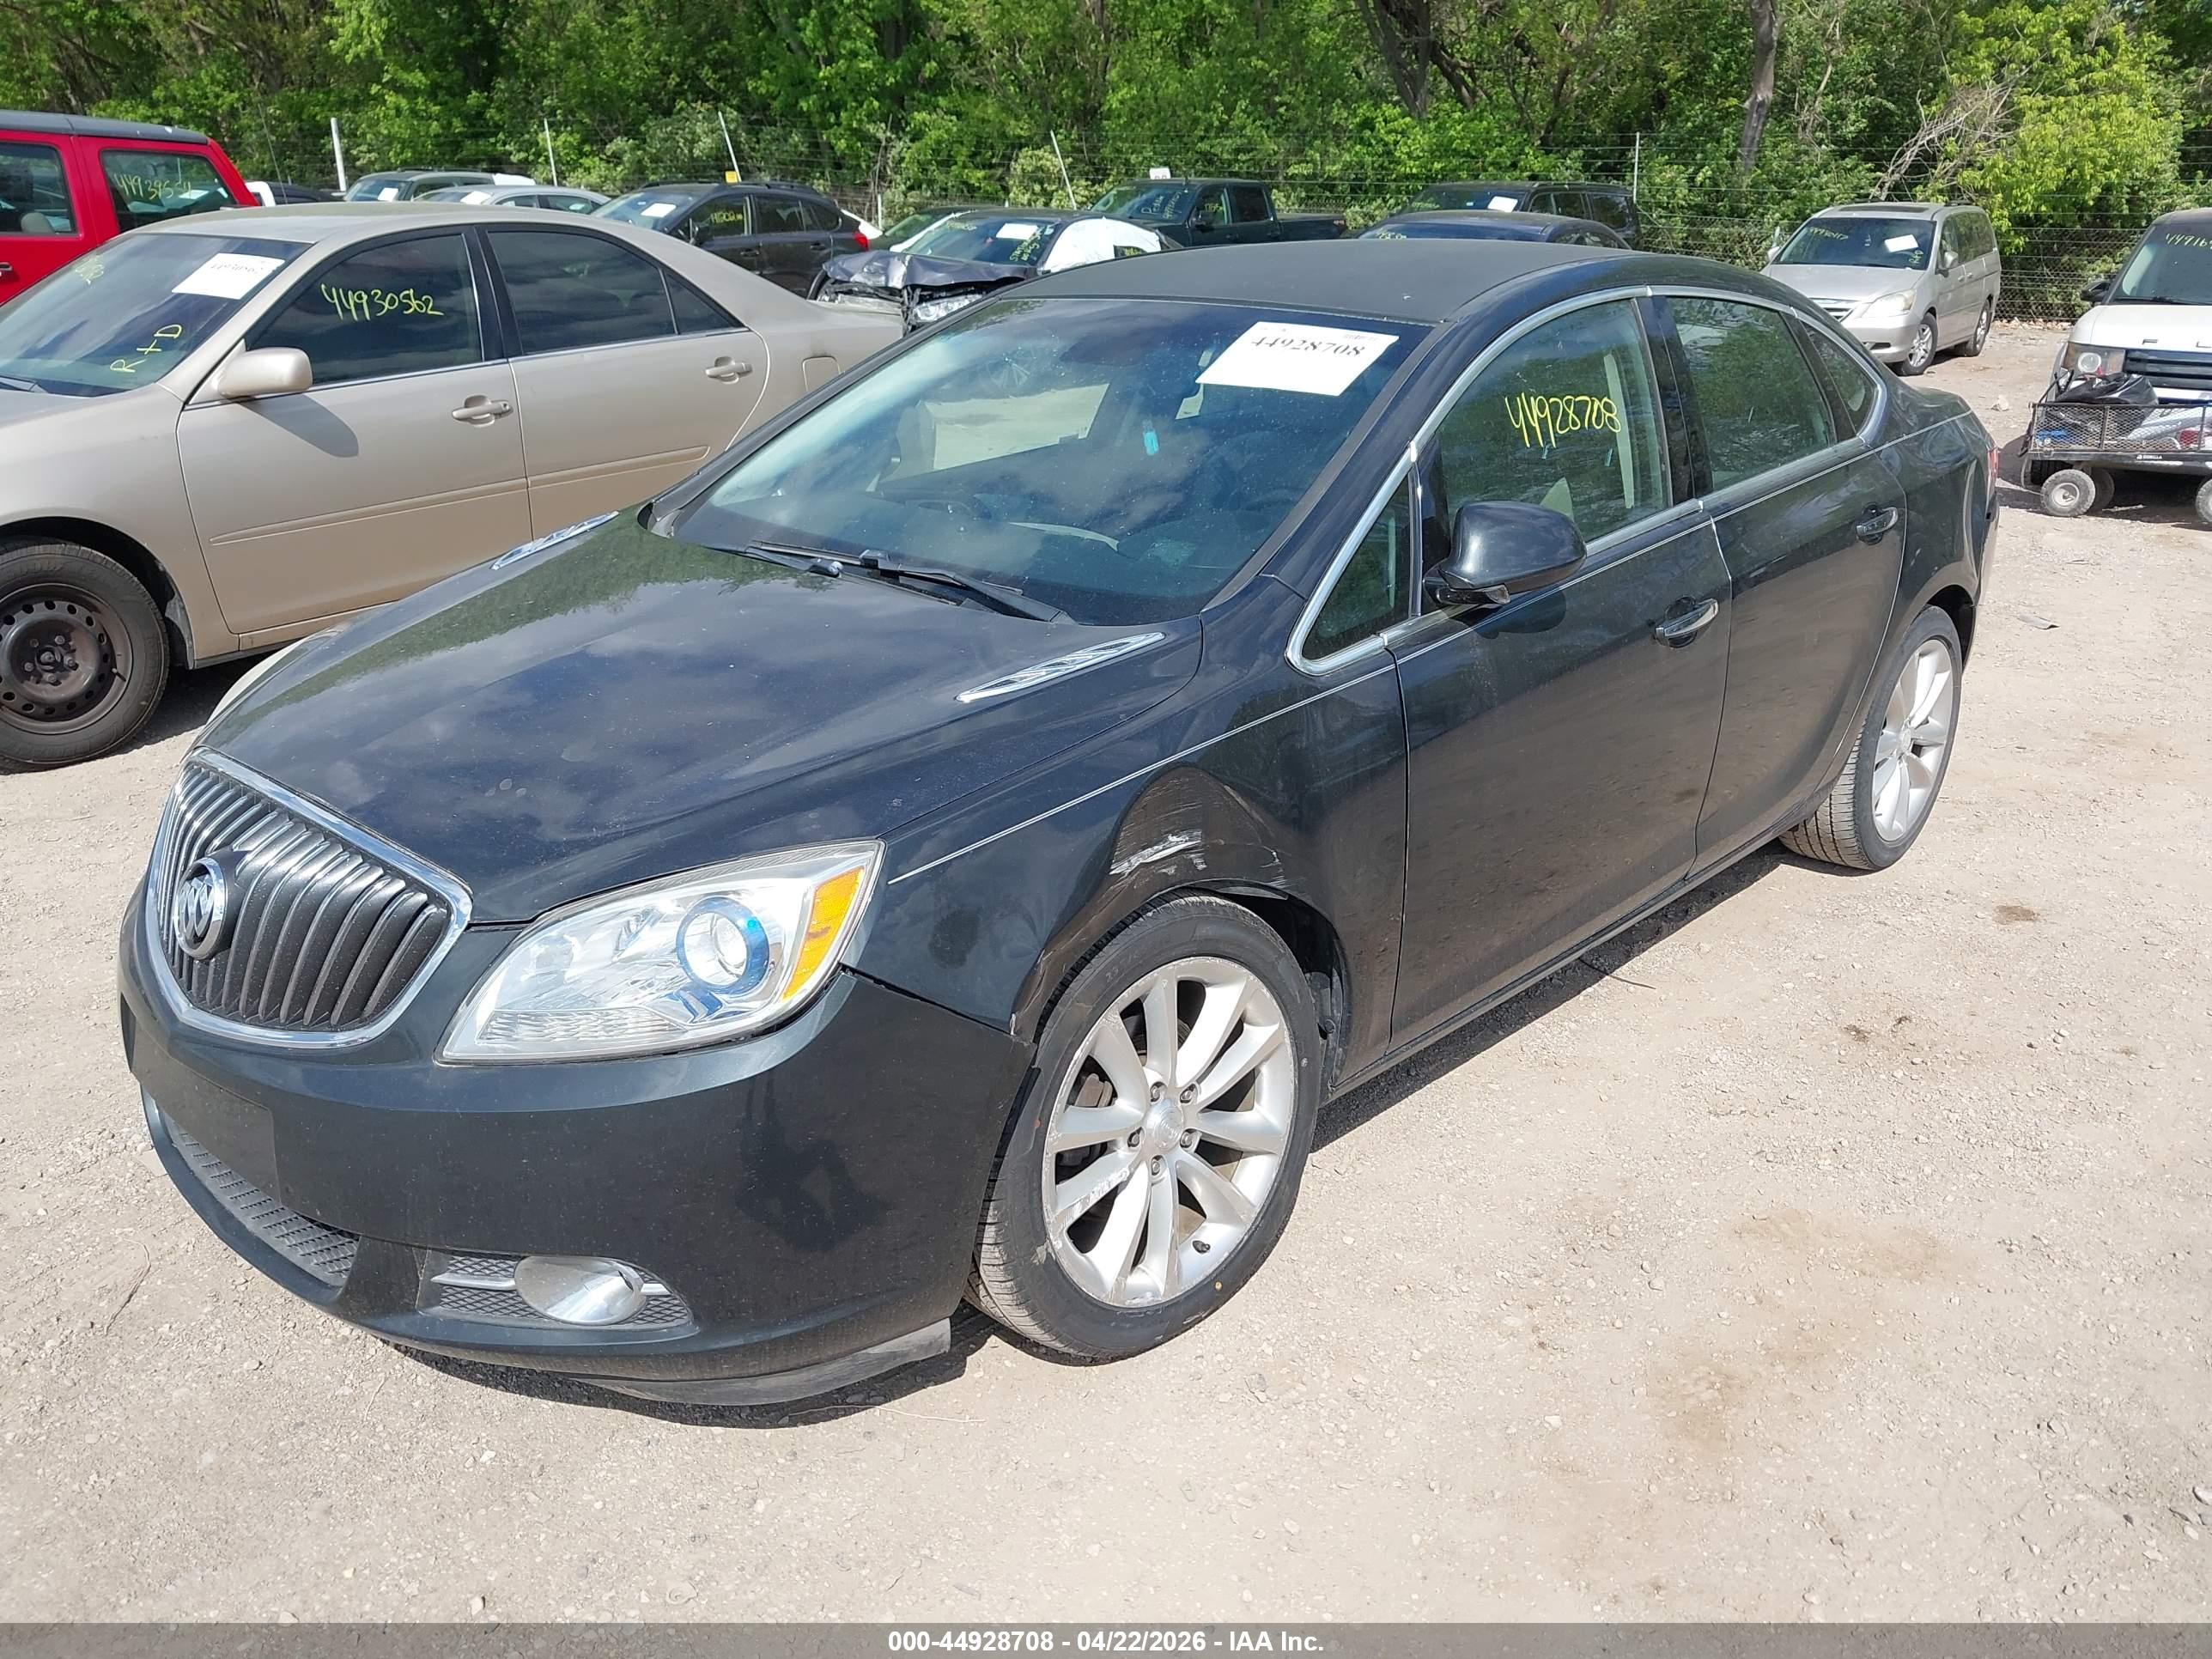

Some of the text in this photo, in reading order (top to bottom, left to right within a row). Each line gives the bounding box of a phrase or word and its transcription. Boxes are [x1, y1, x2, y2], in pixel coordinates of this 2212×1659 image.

[321, 283, 445, 321] 44930562
[1251, 336, 1365, 357] 44928708
[1504, 392, 1621, 447] 44928708
